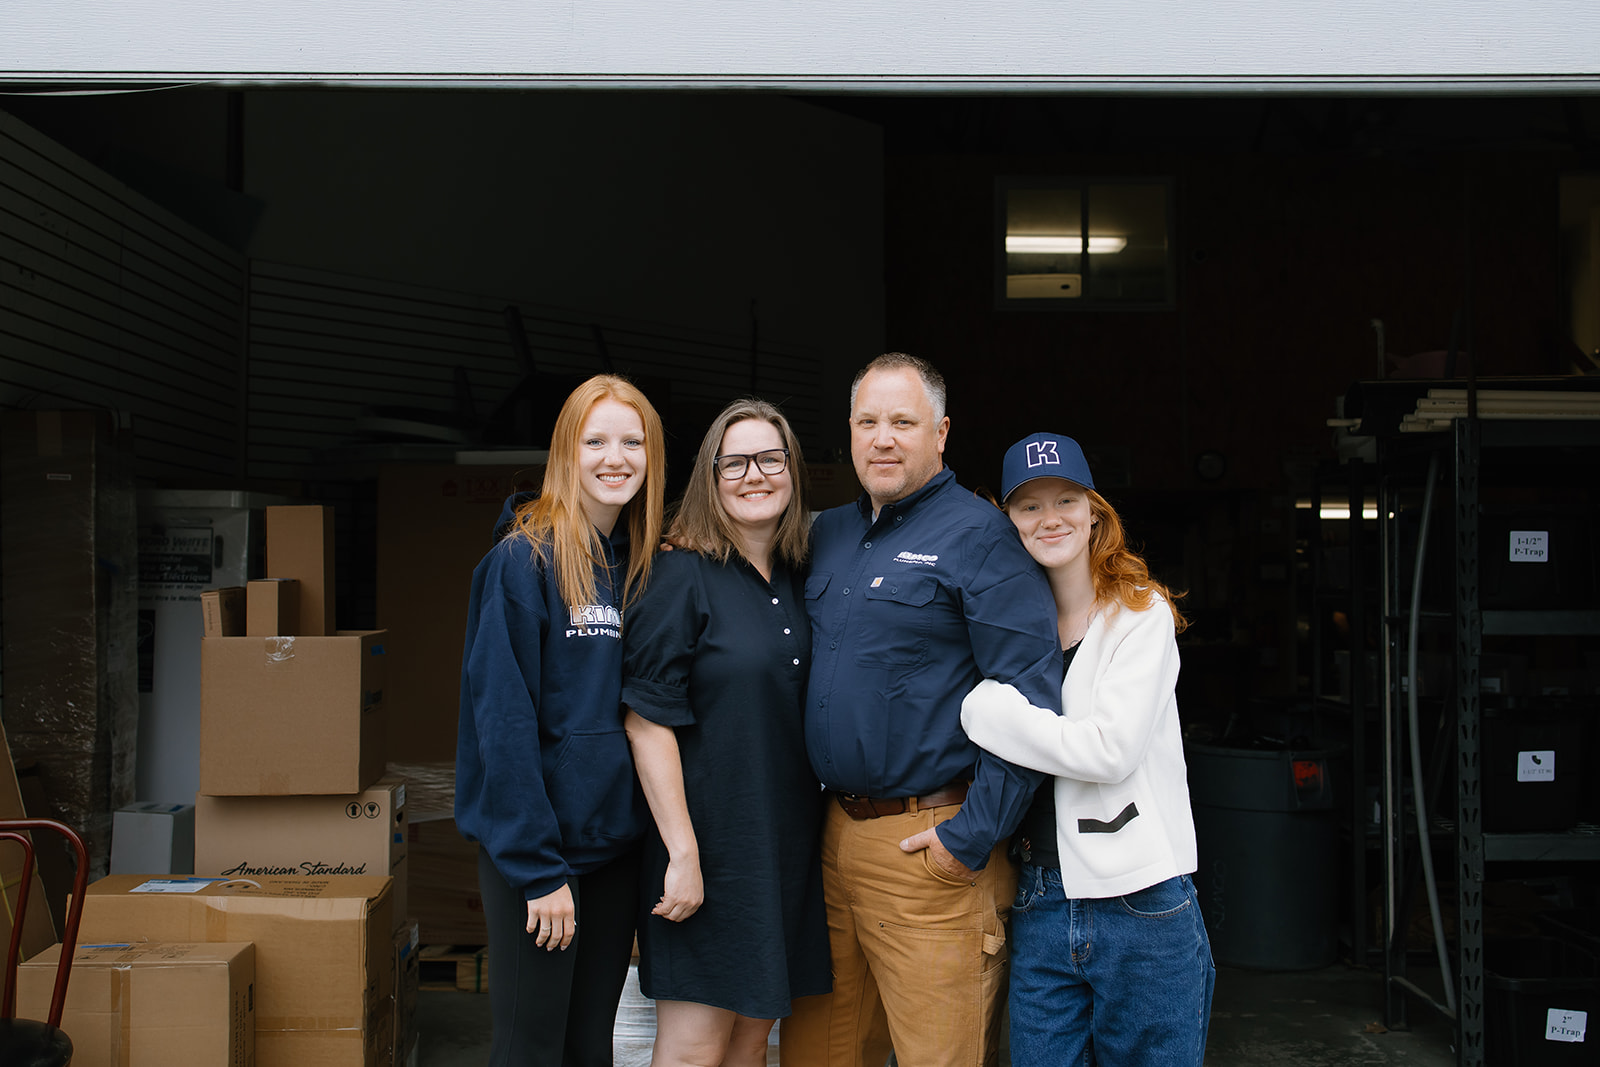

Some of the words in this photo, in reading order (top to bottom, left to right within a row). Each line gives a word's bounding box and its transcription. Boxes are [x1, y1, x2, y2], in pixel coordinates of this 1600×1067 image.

[1025, 441, 1060, 468] K
[1515, 548, 1544, 557] P-Trap
[221, 862, 299, 876] American
[300, 861, 367, 875] Standard
[1551, 1026, 1581, 1038] P-Trap
